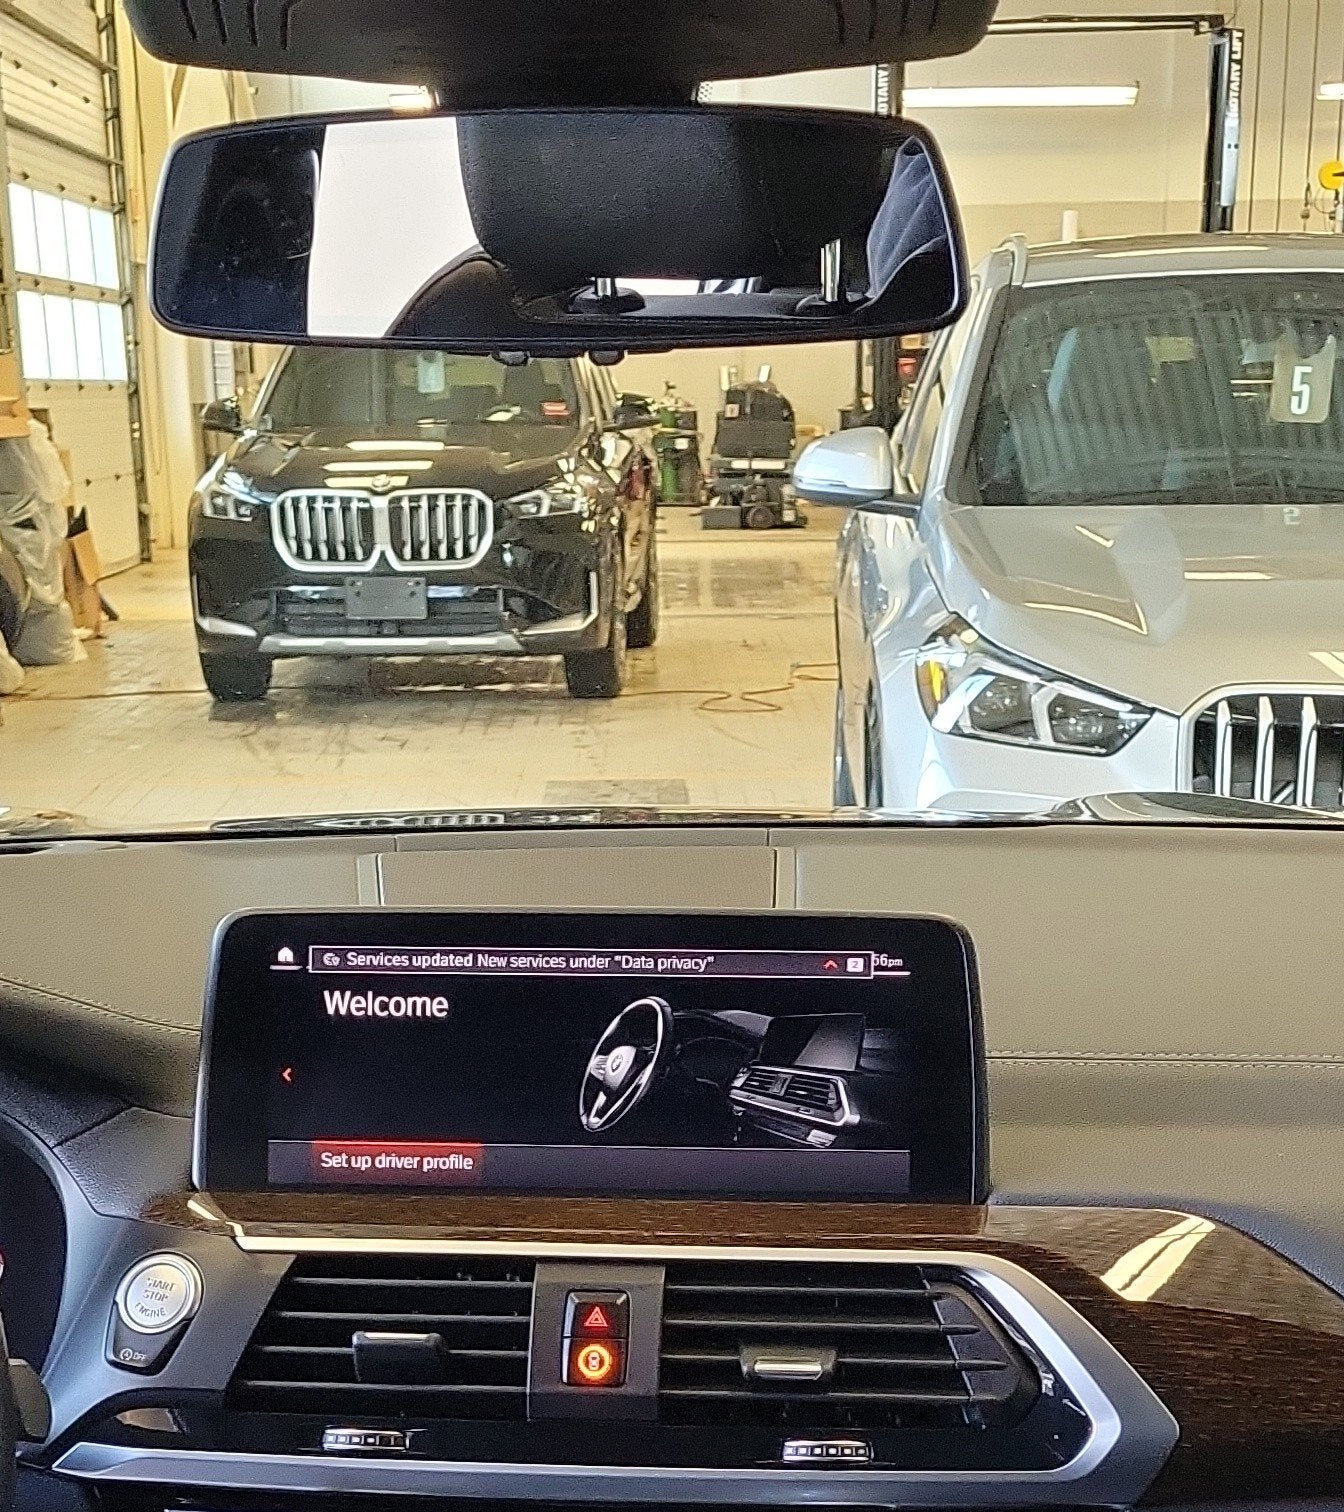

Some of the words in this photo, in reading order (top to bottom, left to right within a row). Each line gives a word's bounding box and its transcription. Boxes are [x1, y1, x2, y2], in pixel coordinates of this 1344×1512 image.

[877, 69, 889, 114] OTARY
[1290, 365, 1313, 415] 5
[346, 951, 410, 968] Services
[412, 952, 473, 972] updated
[476, 953, 508, 968] New
[509, 954, 566, 969] services
[569, 955, 611, 970] under
[323, 989, 449, 1018] Welcome
[320, 1151, 348, 1169] Set
[350, 1155, 372, 1171] up
[374, 1152, 421, 1170] driver
[422, 1153, 474, 1172] profile
[143, 1288, 169, 1303] STOP
